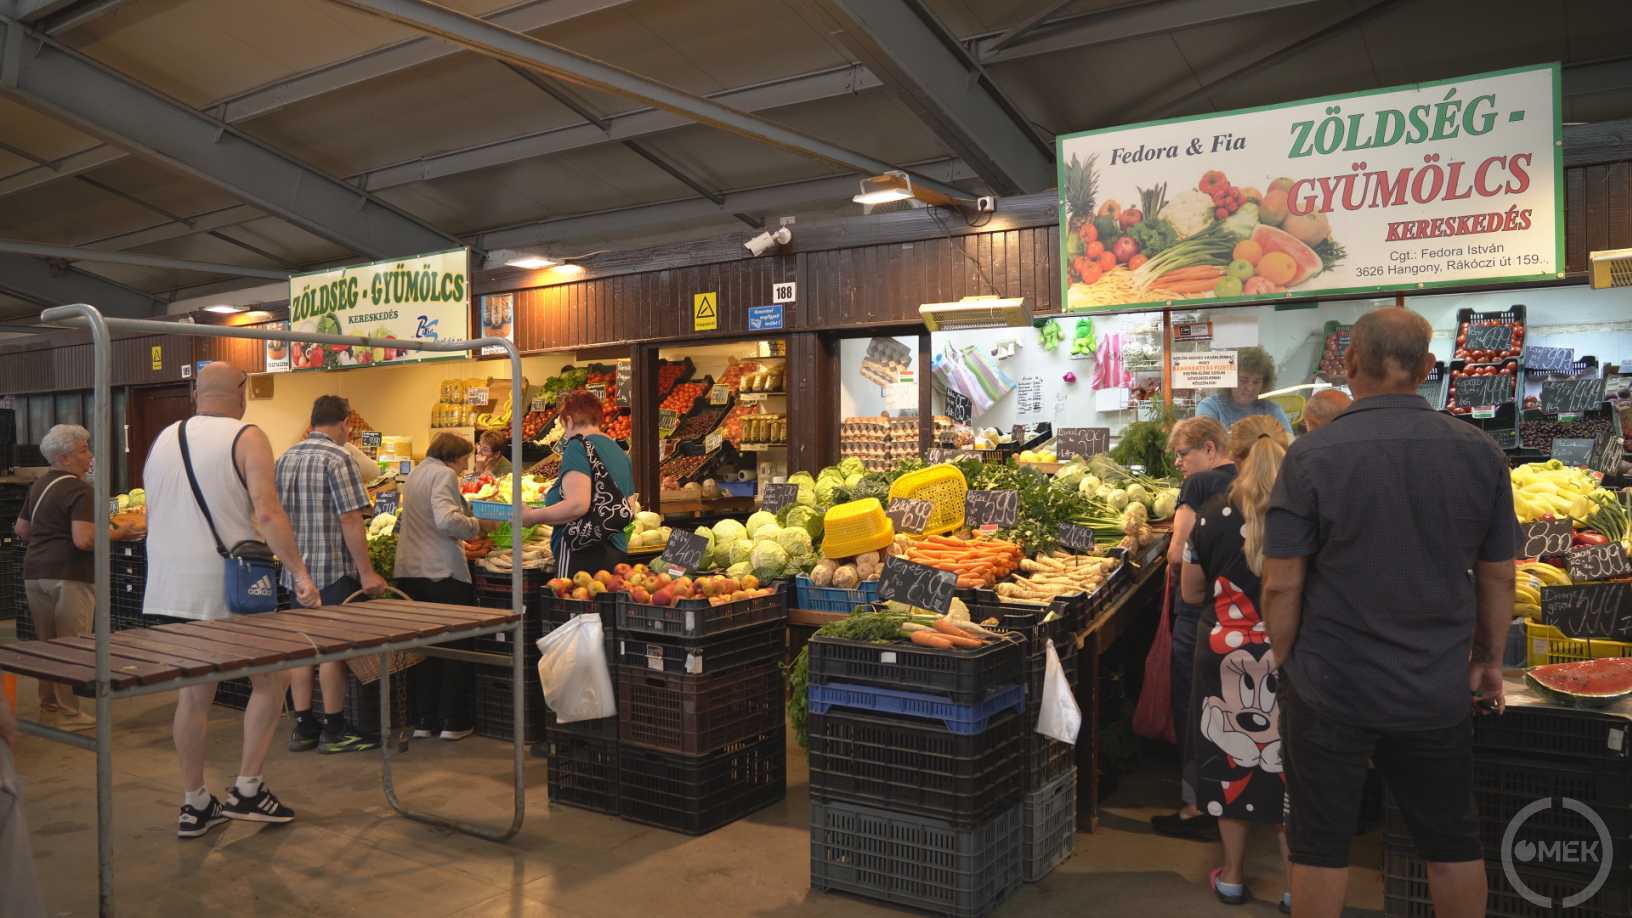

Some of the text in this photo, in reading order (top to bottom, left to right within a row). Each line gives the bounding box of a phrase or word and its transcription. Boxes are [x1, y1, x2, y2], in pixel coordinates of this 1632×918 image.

[1288, 88, 1498, 158] ZÖLDSÉG
[1110, 133, 1248, 166] Fedora & Fia
[1287, 153, 1533, 217] GYÜMÖLCS
[1385, 204, 1532, 242] KERESKEDÉS
[1355, 266, 1384, 277] 3626
[1387, 262, 1443, 277] Hangony,
[1447, 258, 1496, 272] Rákóczi
[1500, 256, 1511, 267] út
[1389, 243, 1504, 263] Cgt.: Fedora István
[292, 269, 358, 323] ZÖLDSÉG
[371, 263, 464, 305] GYÜMÖLCS
[776, 286, 793, 300] 188
[348, 310, 399, 324] KERESKEDÉS
[1525, 520, 1572, 559] 800
[1589, 543, 1625, 578] 599
[247, 588, 272, 597] adidas
